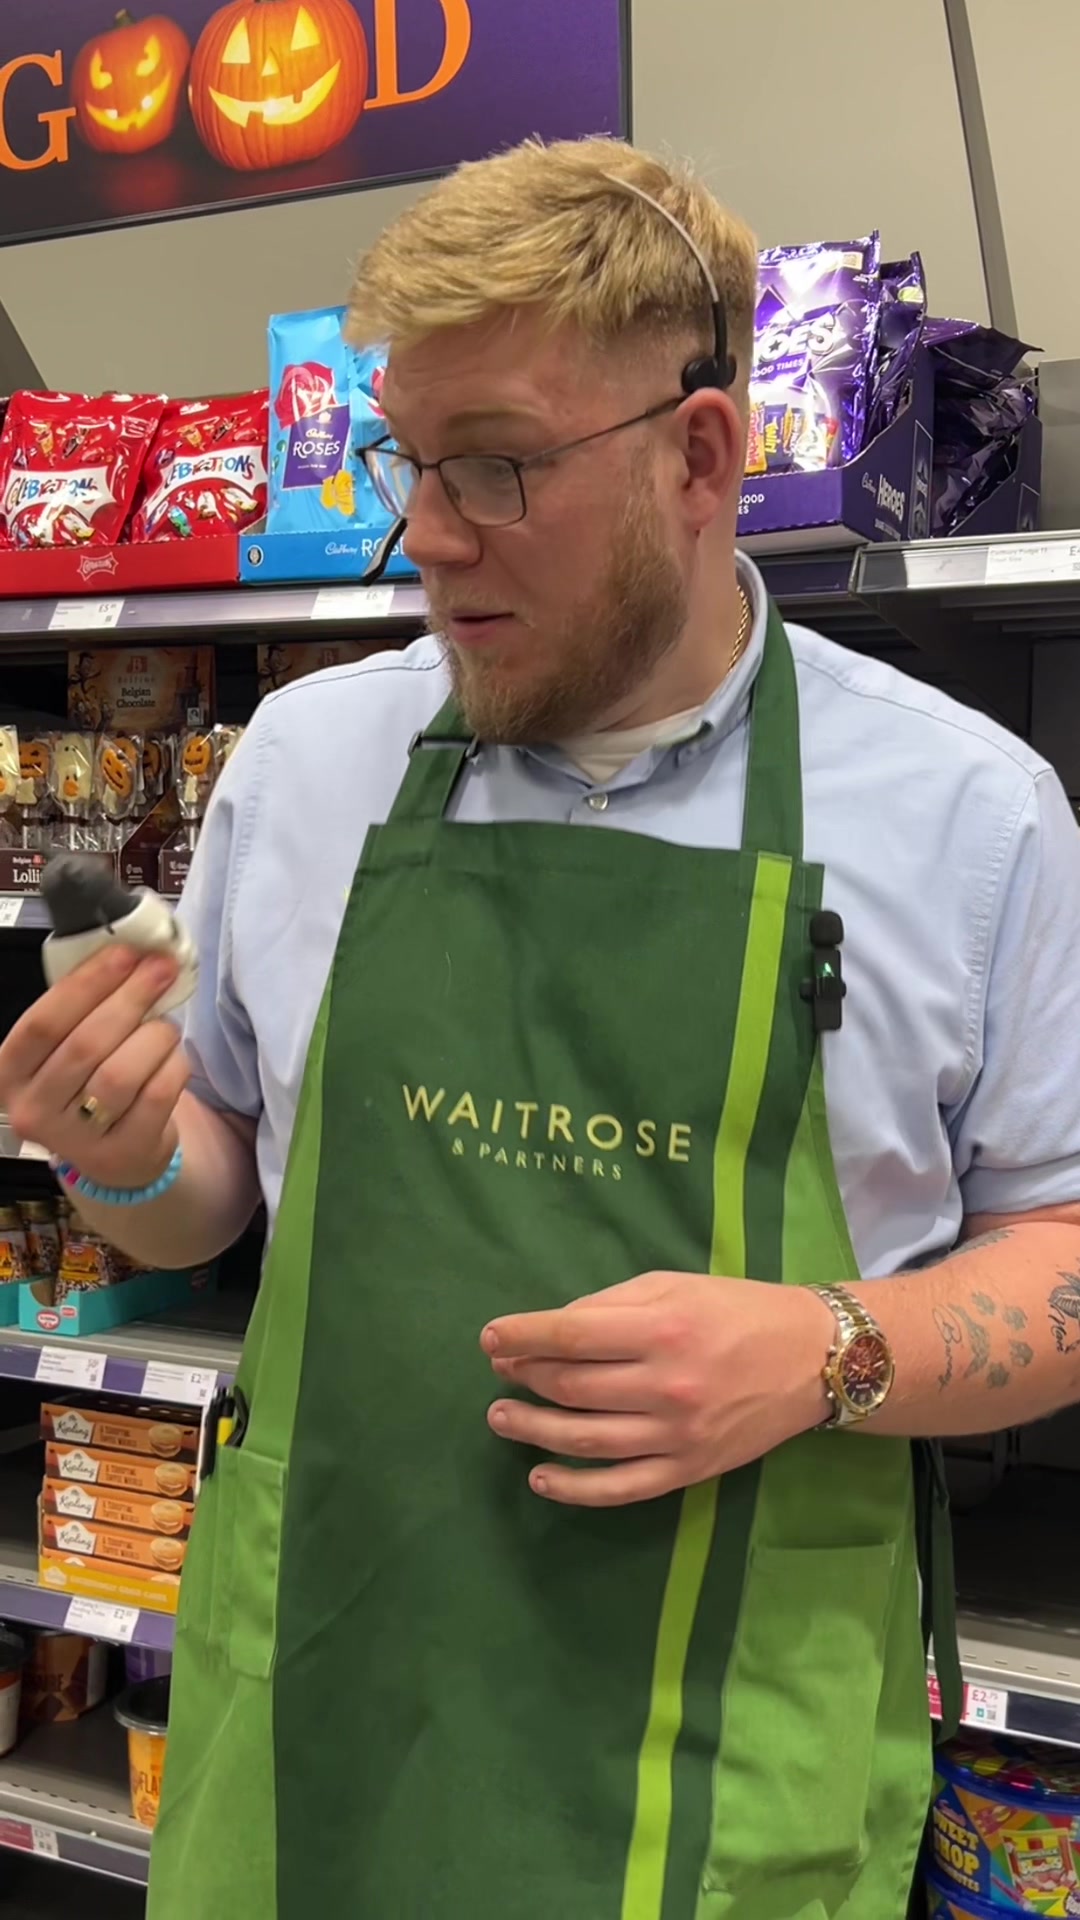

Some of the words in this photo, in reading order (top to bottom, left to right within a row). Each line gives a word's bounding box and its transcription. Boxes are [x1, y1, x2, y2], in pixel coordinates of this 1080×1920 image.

[293, 440, 341, 459] ROSES
[121, 687, 151, 698] Belgian
[116, 698, 156, 709] Chocolate
[13, 869, 42, 884] Lolli
[402, 1084, 692, 1163] WAITROSE
[452, 1137, 464, 1156] &
[479, 1142, 623, 1181] PARTNERS
[57, 1420, 90, 1440] Kipling
[63, 1459, 95, 1478] Kipling
[60, 1495, 92, 1514] Kipling
[60, 1530, 92, 1550] Kipling
